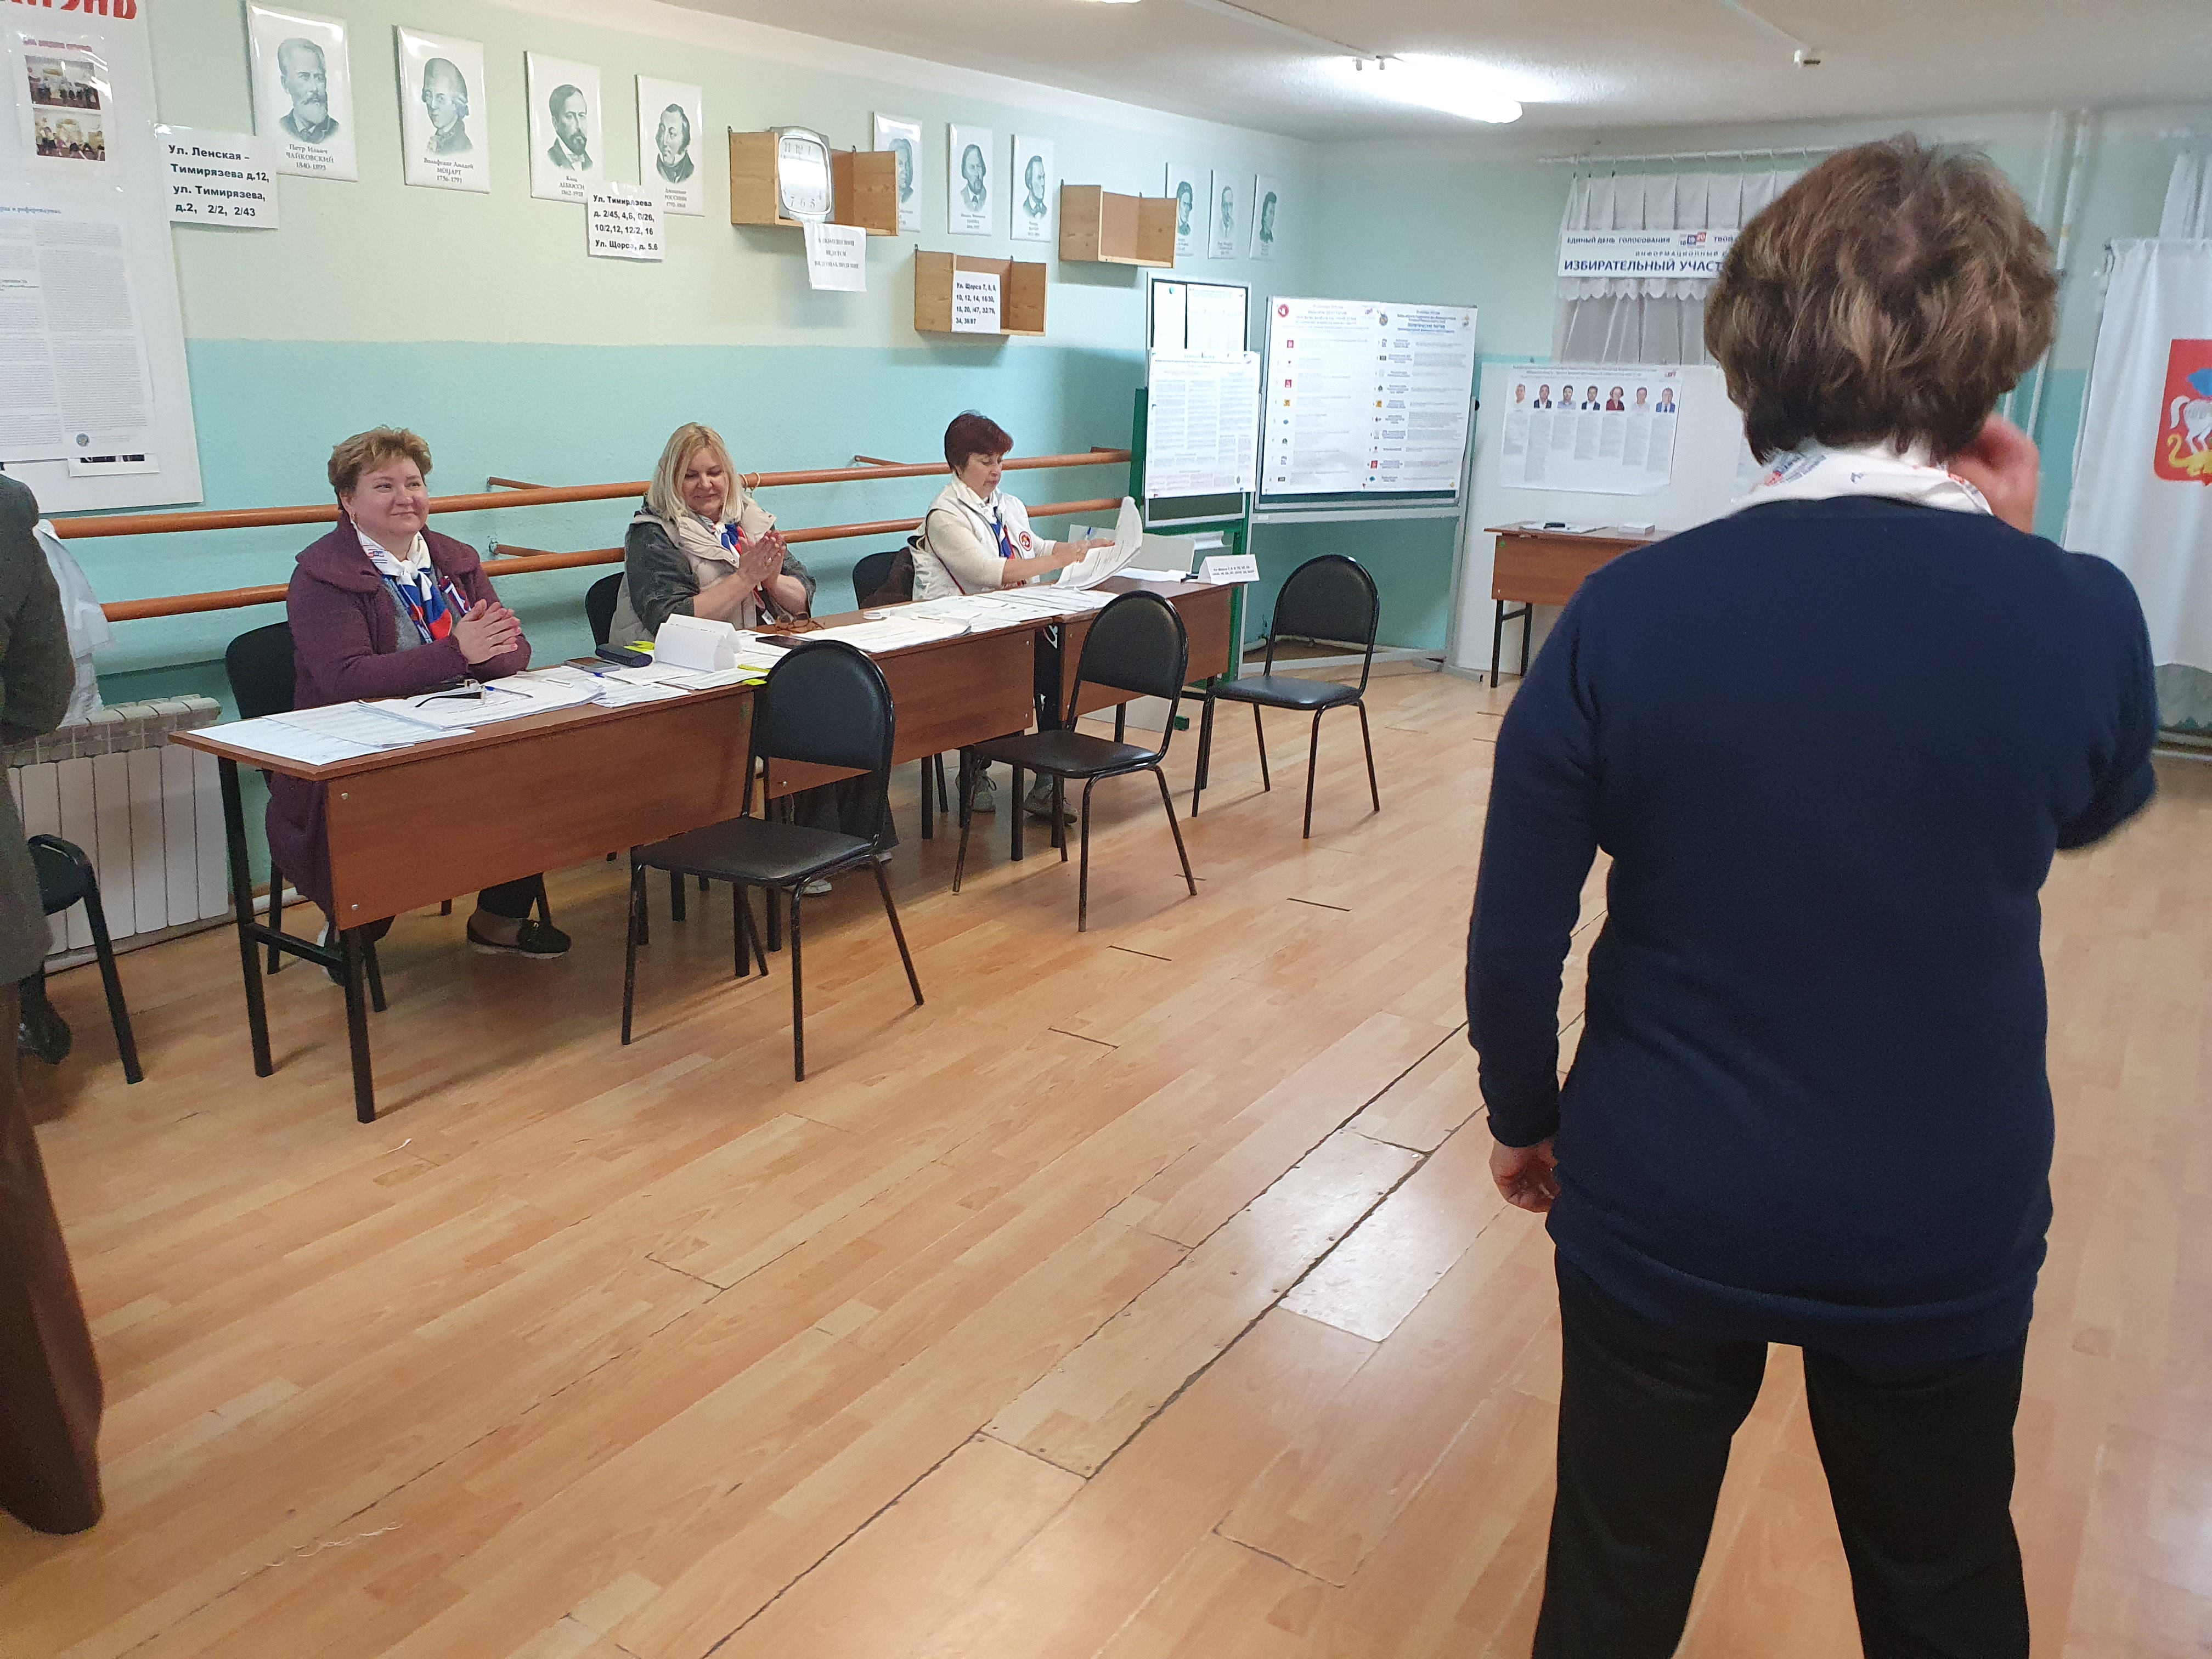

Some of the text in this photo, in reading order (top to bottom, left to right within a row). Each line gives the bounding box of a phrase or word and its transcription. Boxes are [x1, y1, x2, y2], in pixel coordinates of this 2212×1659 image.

[168, 144, 188, 155] Ул.
[192, 147, 241, 160] Ленская
[286, 152, 334, 163] ЧАЙКОВСКИЙ
[171, 163, 269, 183] Тимирязева д.12,
[173, 185, 266, 201] ул. Тимирязева,
[607, 196, 652, 206] Тимирязева
[176, 203, 255, 216] д.2, 2/2, 2/43
[603, 210, 620, 220] 2/45,
[1565, 258, 1724, 272] ИЗБИРАТЕЛЬНЫЙ УЧАСТ
